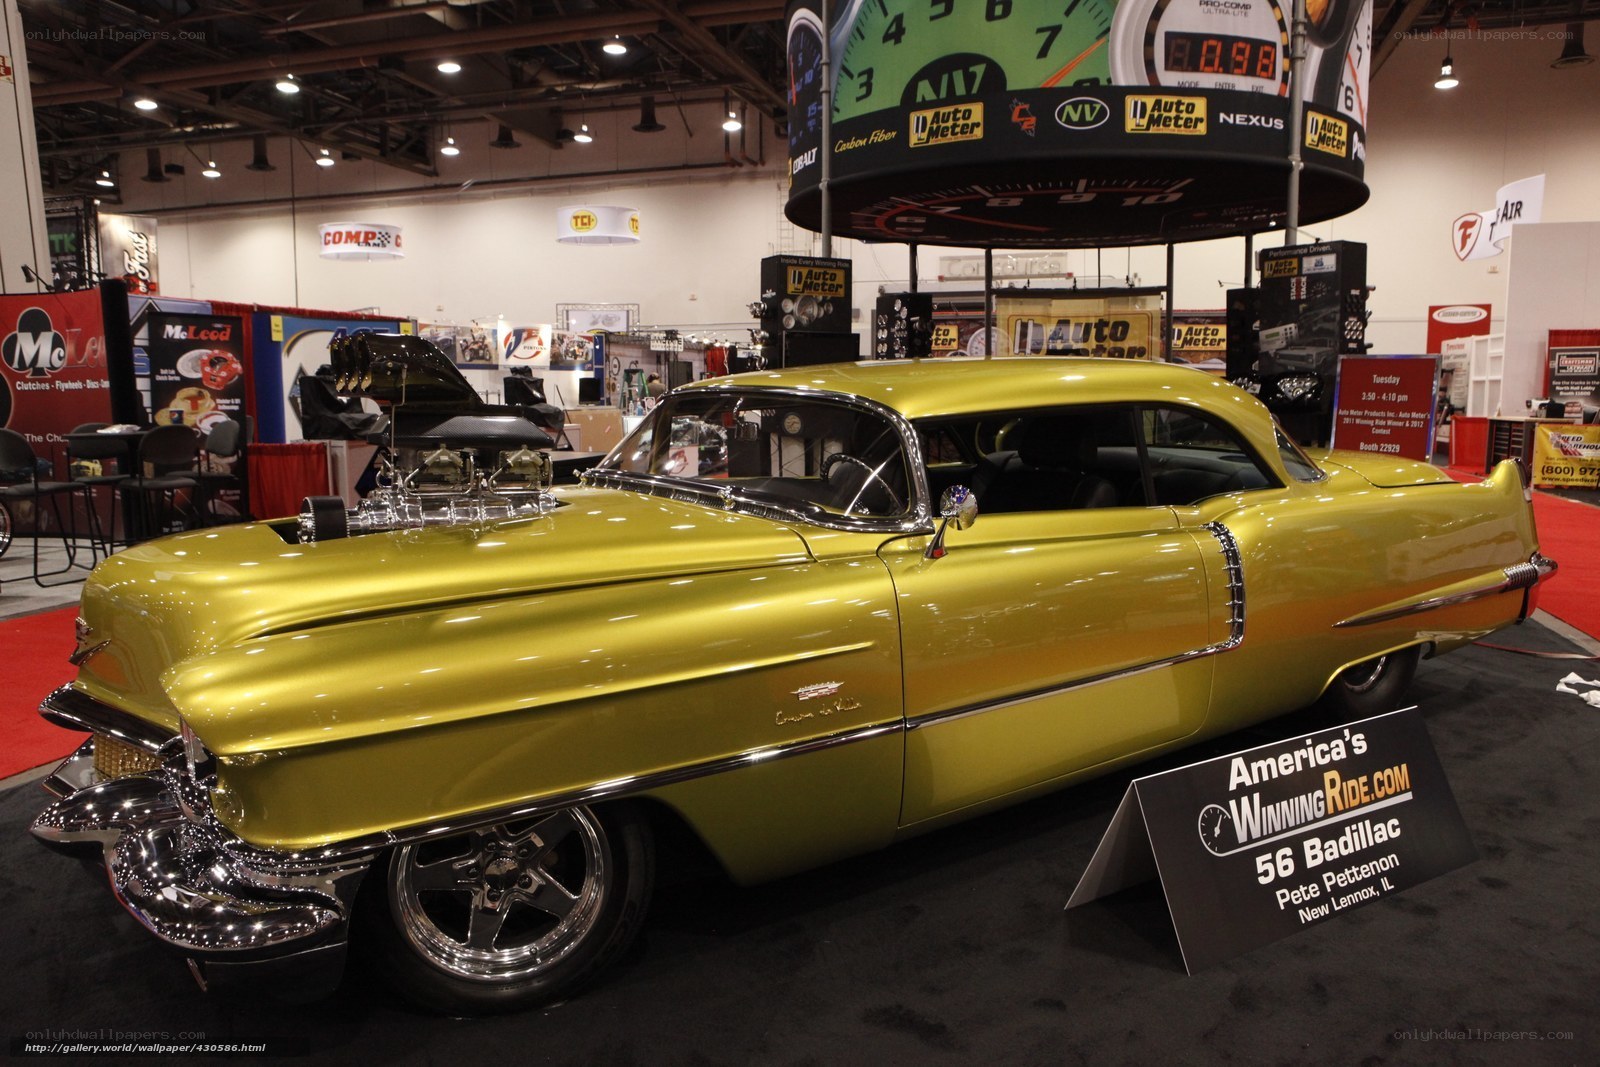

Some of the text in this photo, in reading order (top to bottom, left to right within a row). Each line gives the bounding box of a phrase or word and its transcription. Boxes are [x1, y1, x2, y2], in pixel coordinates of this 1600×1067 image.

[882, 12, 906, 46] 4
[1035, 24, 1063, 60] 7
[855, 66, 874, 103] 3
[1150, 98, 1196, 114] Auto
[1344, 85, 1354, 112] 6
[930, 108, 973, 125] Auto
[1061, 104, 1102, 122] NV
[1148, 113, 1204, 131] Meter
[1219, 112, 1285, 130] NEXUS
[927, 121, 981, 141] Meter
[1320, 118, 1343, 137] Auto
[834, 129, 898, 153] Carbon Fiber
[1318, 131, 1346, 151] Meter
[793, 147, 818, 175] COBALT
[573, 214, 592, 227] TCI
[1500, 200, 1523, 223] AIR
[49, 232, 77, 254] TK
[323, 230, 377, 246] COMP
[805, 268, 837, 281] Auto
[803, 280, 843, 292] Meter
[163, 323, 232, 341] McLeod
[1049, 318, 1130, 344] Auto
[1184, 326, 1219, 337] Auto
[1181, 336, 1226, 348] Meter
[16, 380, 50, 390] Clutches
[55, 380, 83, 392] Flywheels
[1372, 374, 1401, 385] Tuesday
[1361, 391, 1376, 401] 3:50
[1381, 392, 1397, 402] 4:10
[1397, 394, 1409, 403] pm
[1355, 418, 1374, 426] Winning
[1387, 419, 1404, 427] Winner
[1410, 420, 1424, 428] 2012
[1411, 411, 1431, 419] Meter's
[25, 433, 43, 443] The
[1371, 427, 1391, 435] Contest
[1359, 441, 1401, 453] Booth 22929
[1541, 465, 1575, 477] (800)
[1228, 729, 1368, 791] America's
[1256, 817, 1401, 885] 56 Badillac
[1275, 852, 1400, 910] Pete Pettenon
[1298, 876, 1395, 924] New Lennox, IL
